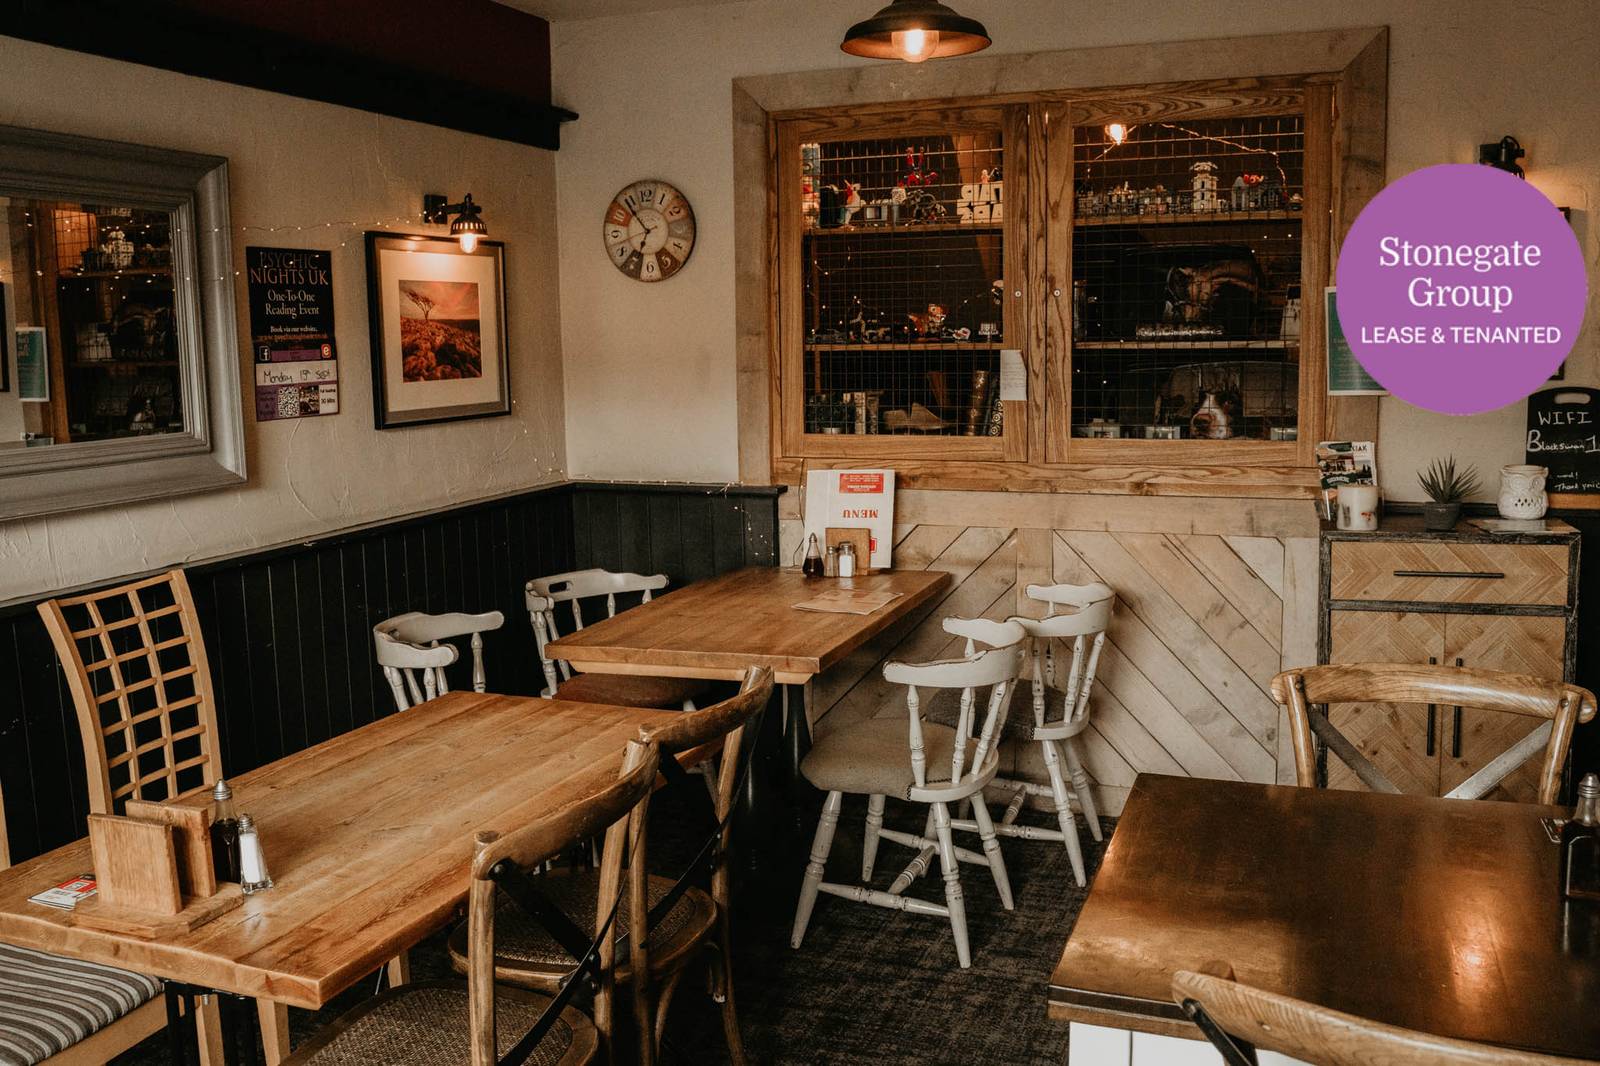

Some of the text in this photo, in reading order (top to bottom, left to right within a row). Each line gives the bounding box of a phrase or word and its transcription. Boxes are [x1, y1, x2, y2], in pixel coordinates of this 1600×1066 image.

[640, 189, 652, 202] 12
[659, 193, 666, 205] 1
[613, 209, 625, 222] 10
[669, 207, 682, 216] 2
[611, 230, 623, 239] 9
[260, 251, 318, 270] PSYCHIC
[646, 261, 655, 273] 6
[662, 255, 671, 268] 5
[250, 268, 329, 286] NIGHTS UK
[267, 288, 316, 303] One-To-One
[265, 302, 320, 320] Reading Event
[263, 370, 294, 383] Monday
[1538, 410, 1593, 425] WIFI
[843, 509, 879, 519] MENU
